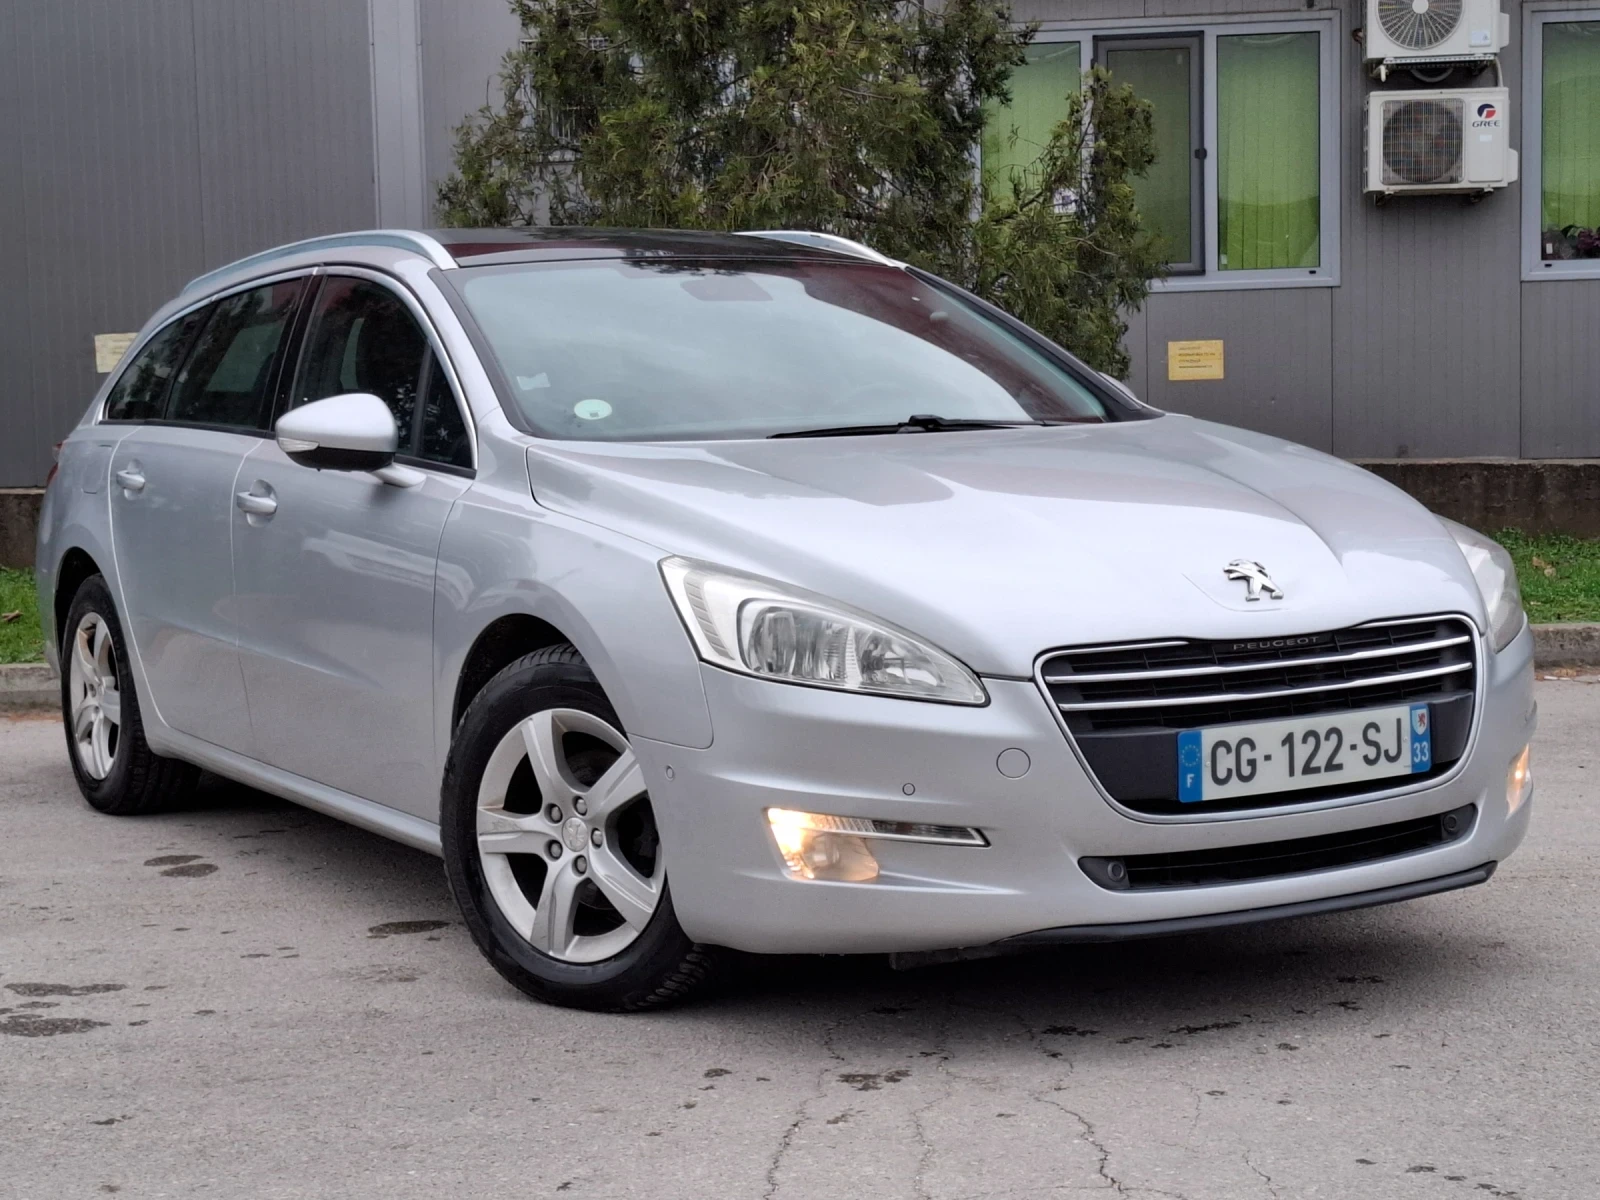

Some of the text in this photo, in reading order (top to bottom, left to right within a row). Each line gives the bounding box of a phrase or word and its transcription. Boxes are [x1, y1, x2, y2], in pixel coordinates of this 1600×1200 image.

[1472, 120, 1500, 128] GREE
[1233, 636, 1319, 650] PEUGEOT
[1210, 718, 1402, 786] CG-122-SJ
[1413, 741, 1429, 763] 33
[1186, 773, 1195, 789] F
